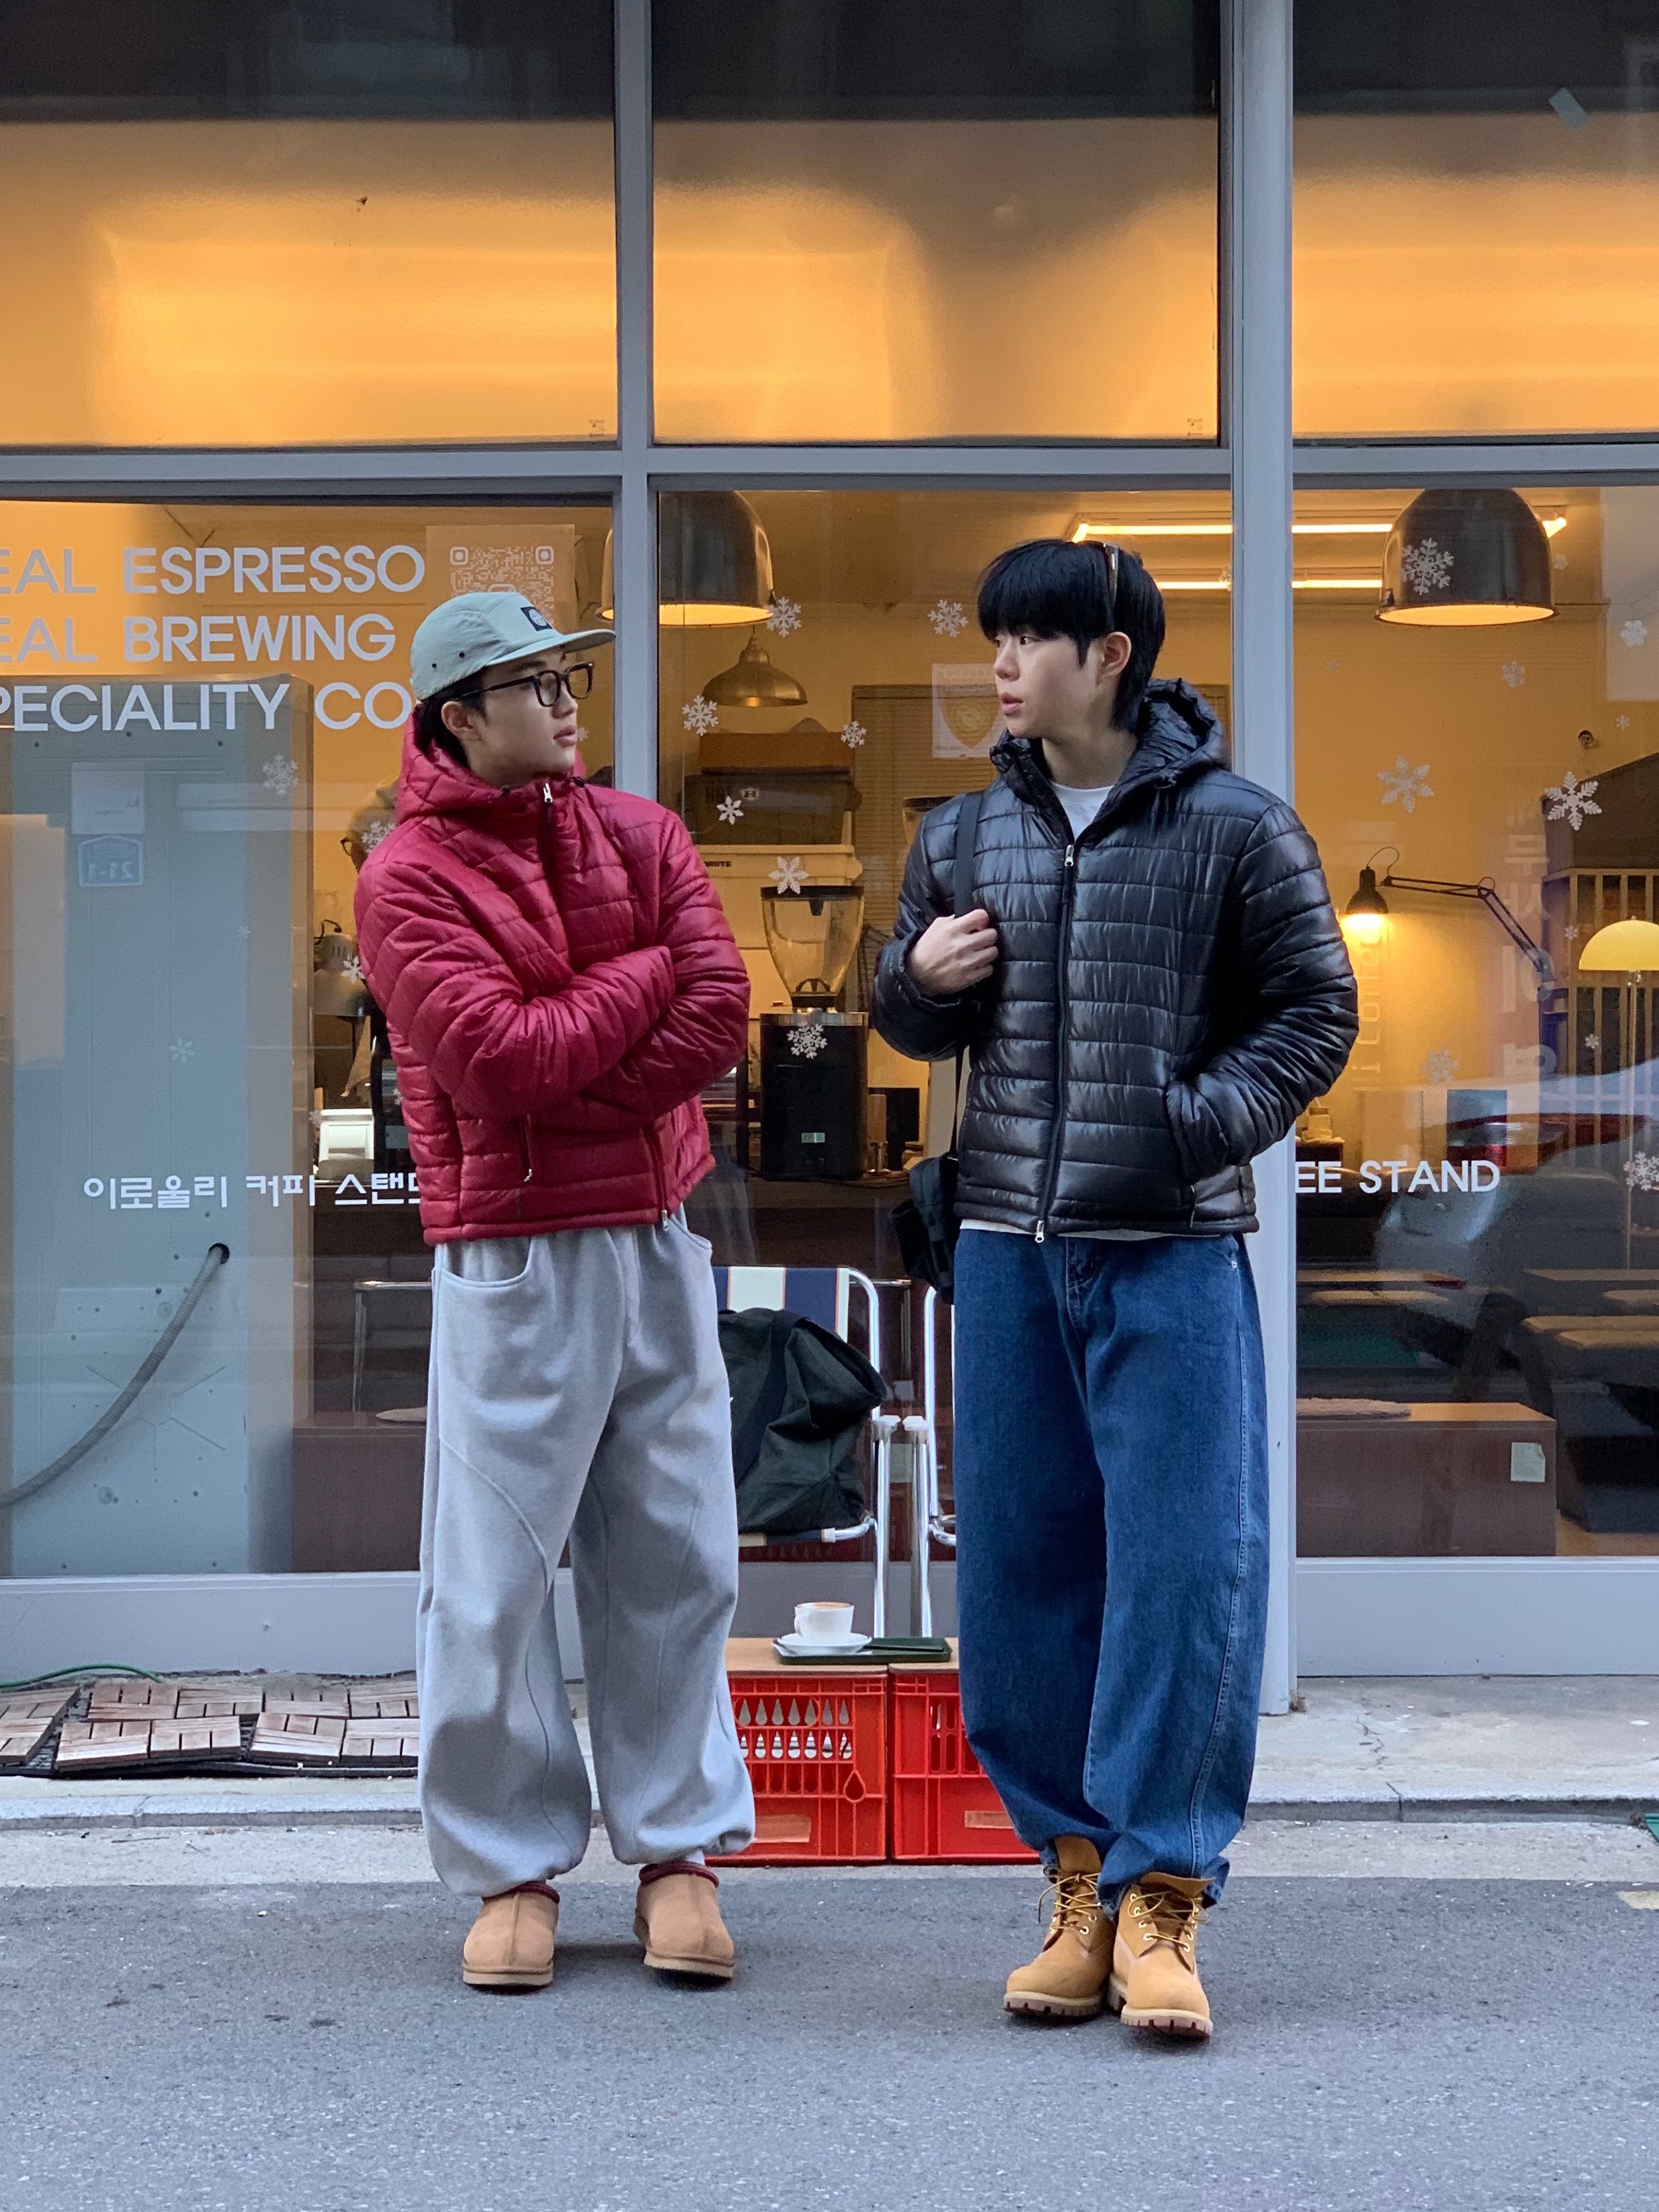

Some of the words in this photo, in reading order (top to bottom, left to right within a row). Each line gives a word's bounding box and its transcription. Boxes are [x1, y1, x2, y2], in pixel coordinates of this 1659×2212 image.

[123, 545, 425, 595] ESPRESSO
[123, 613, 396, 662] BREWING
[314, 681, 412, 730] CO
[83, 1175, 228, 1210] 이로울리
[245, 1175, 316, 1207] 커피
[1295, 1161, 1342, 1193] EE
[1359, 1160, 1501, 1194] STAND
